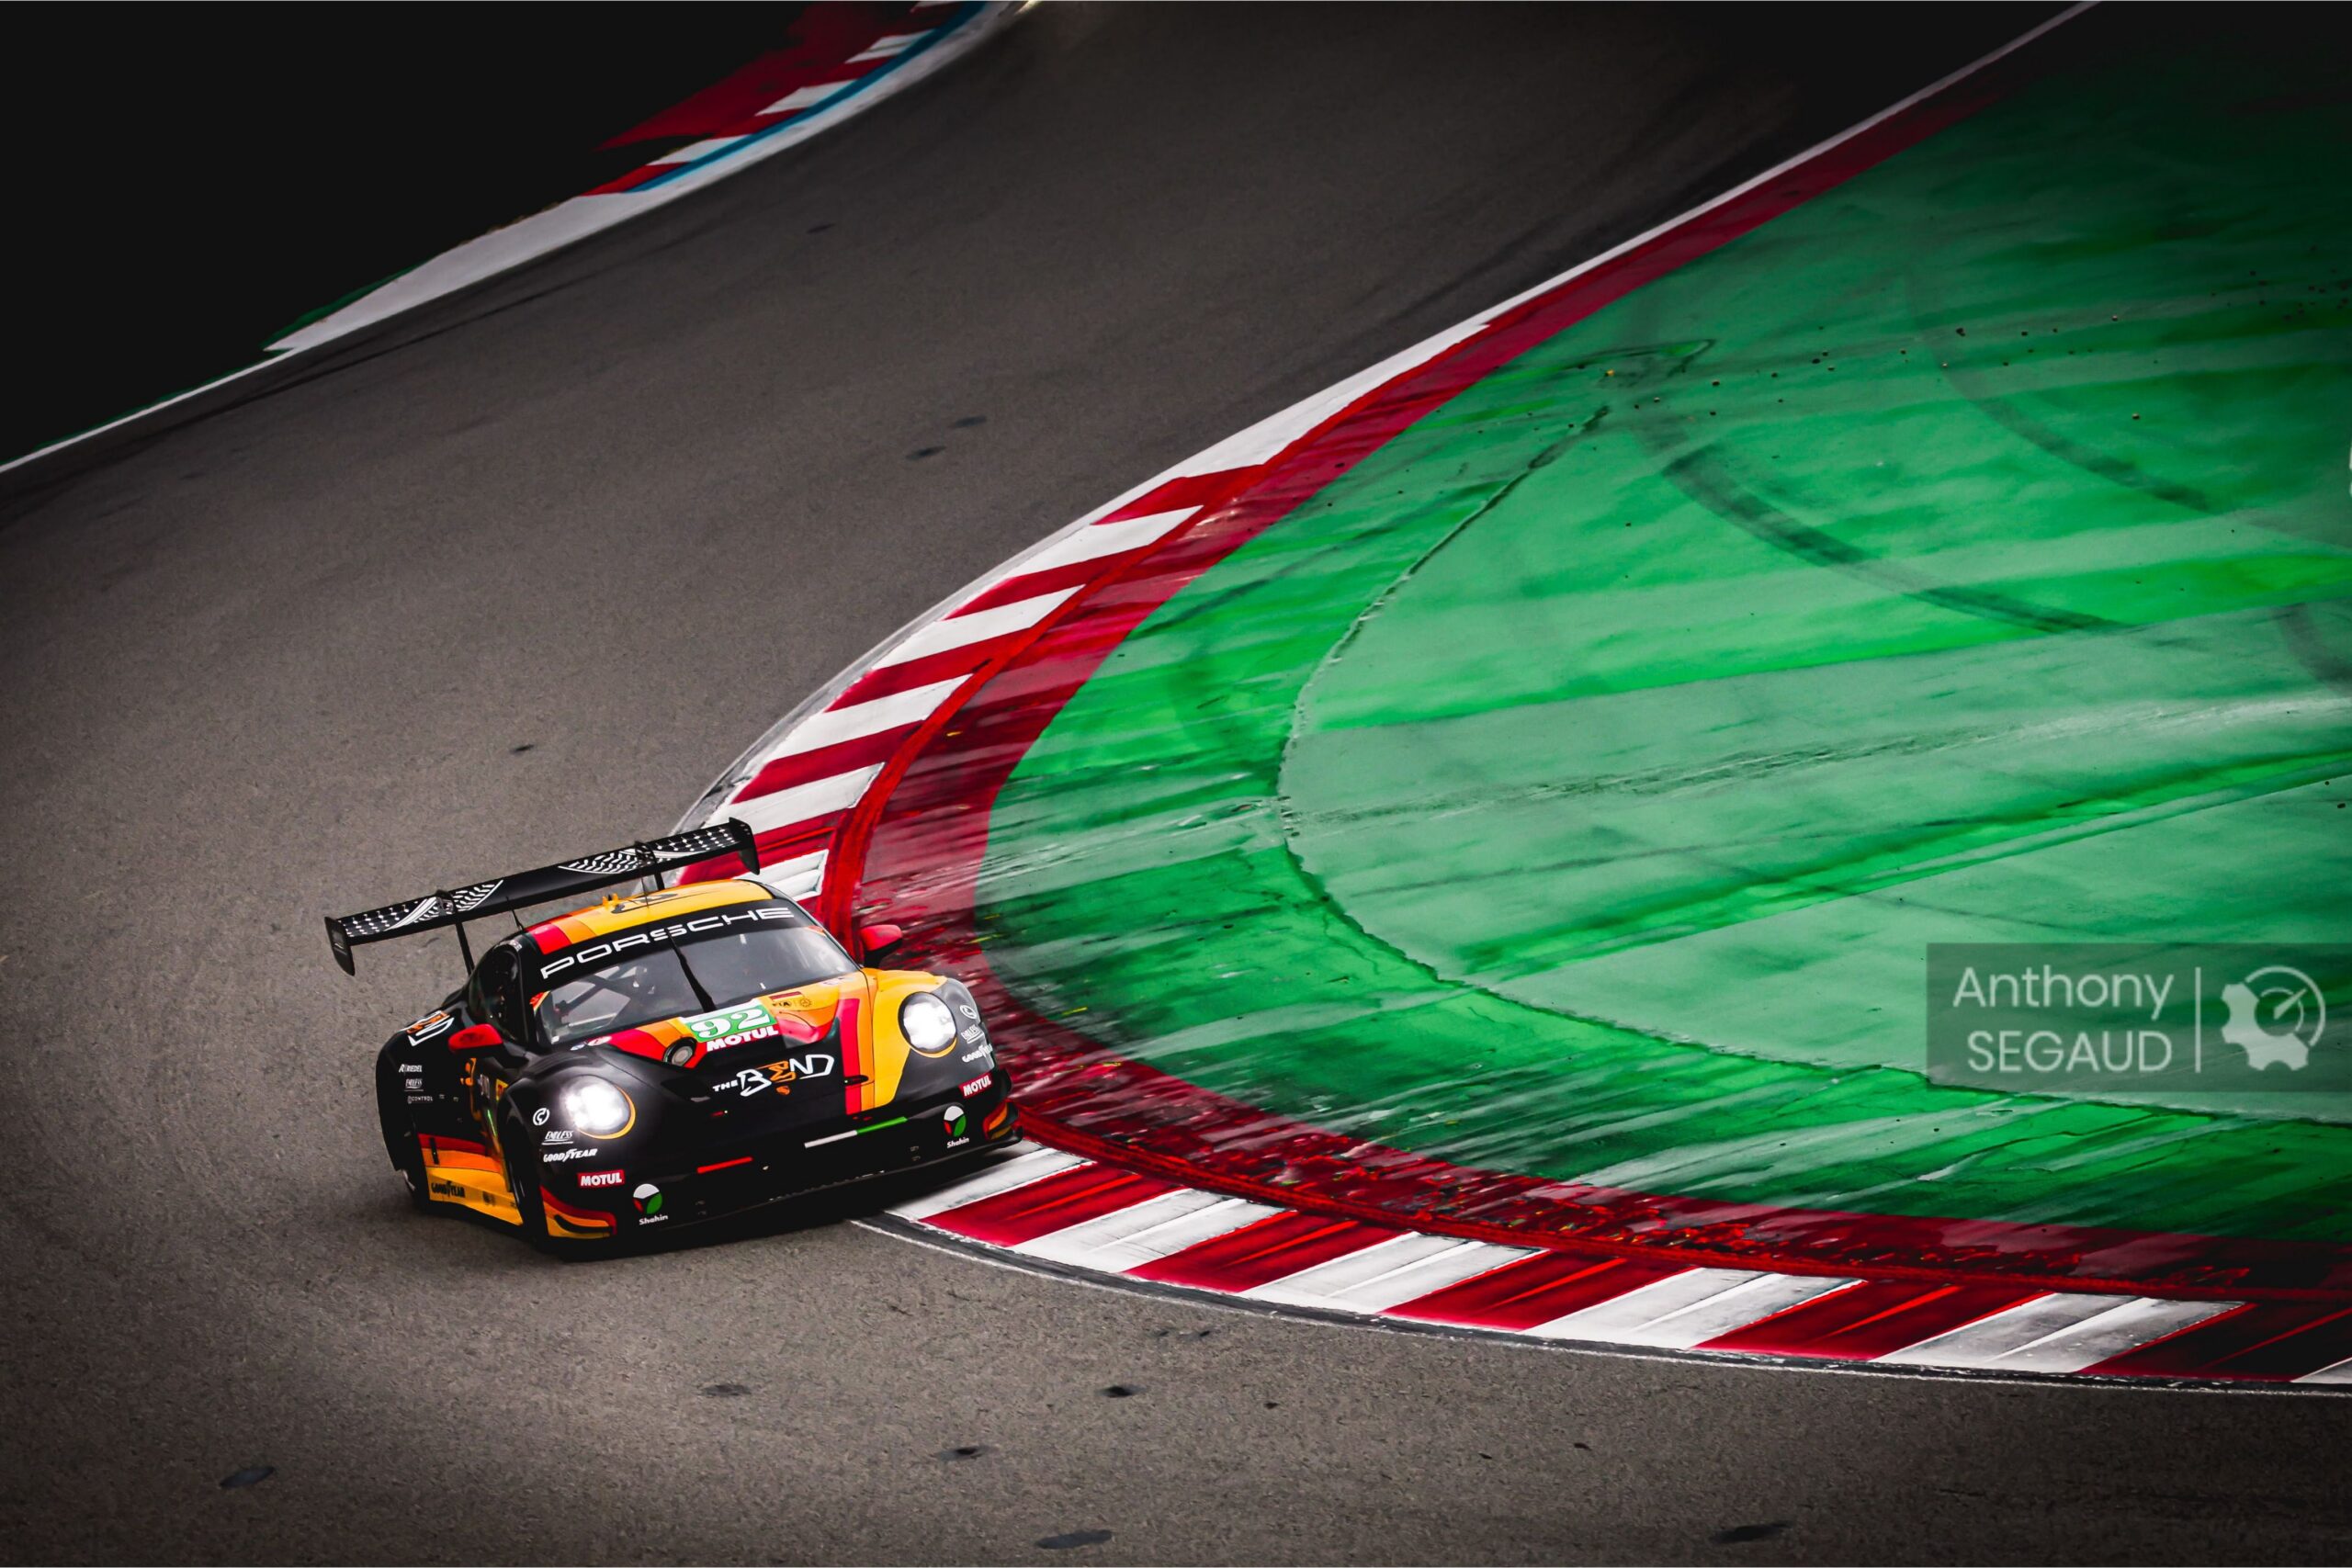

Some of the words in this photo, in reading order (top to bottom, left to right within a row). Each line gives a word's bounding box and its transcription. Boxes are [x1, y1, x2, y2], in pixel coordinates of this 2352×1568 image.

[540, 907, 795, 979] PORSCHE
[691, 1005, 771, 1038] 92
[707, 1026, 779, 1052] MOTUL
[712, 1080, 738, 1091] THE
[963, 1075, 992, 1097] MOTUL
[544, 1130, 574, 1140] ENDLESS
[946, 1136, 970, 1148] Shahin
[543, 1148, 598, 1162] GOODYEAR
[580, 1172, 623, 1187] MOTUL
[639, 1214, 669, 1224] Shahin
